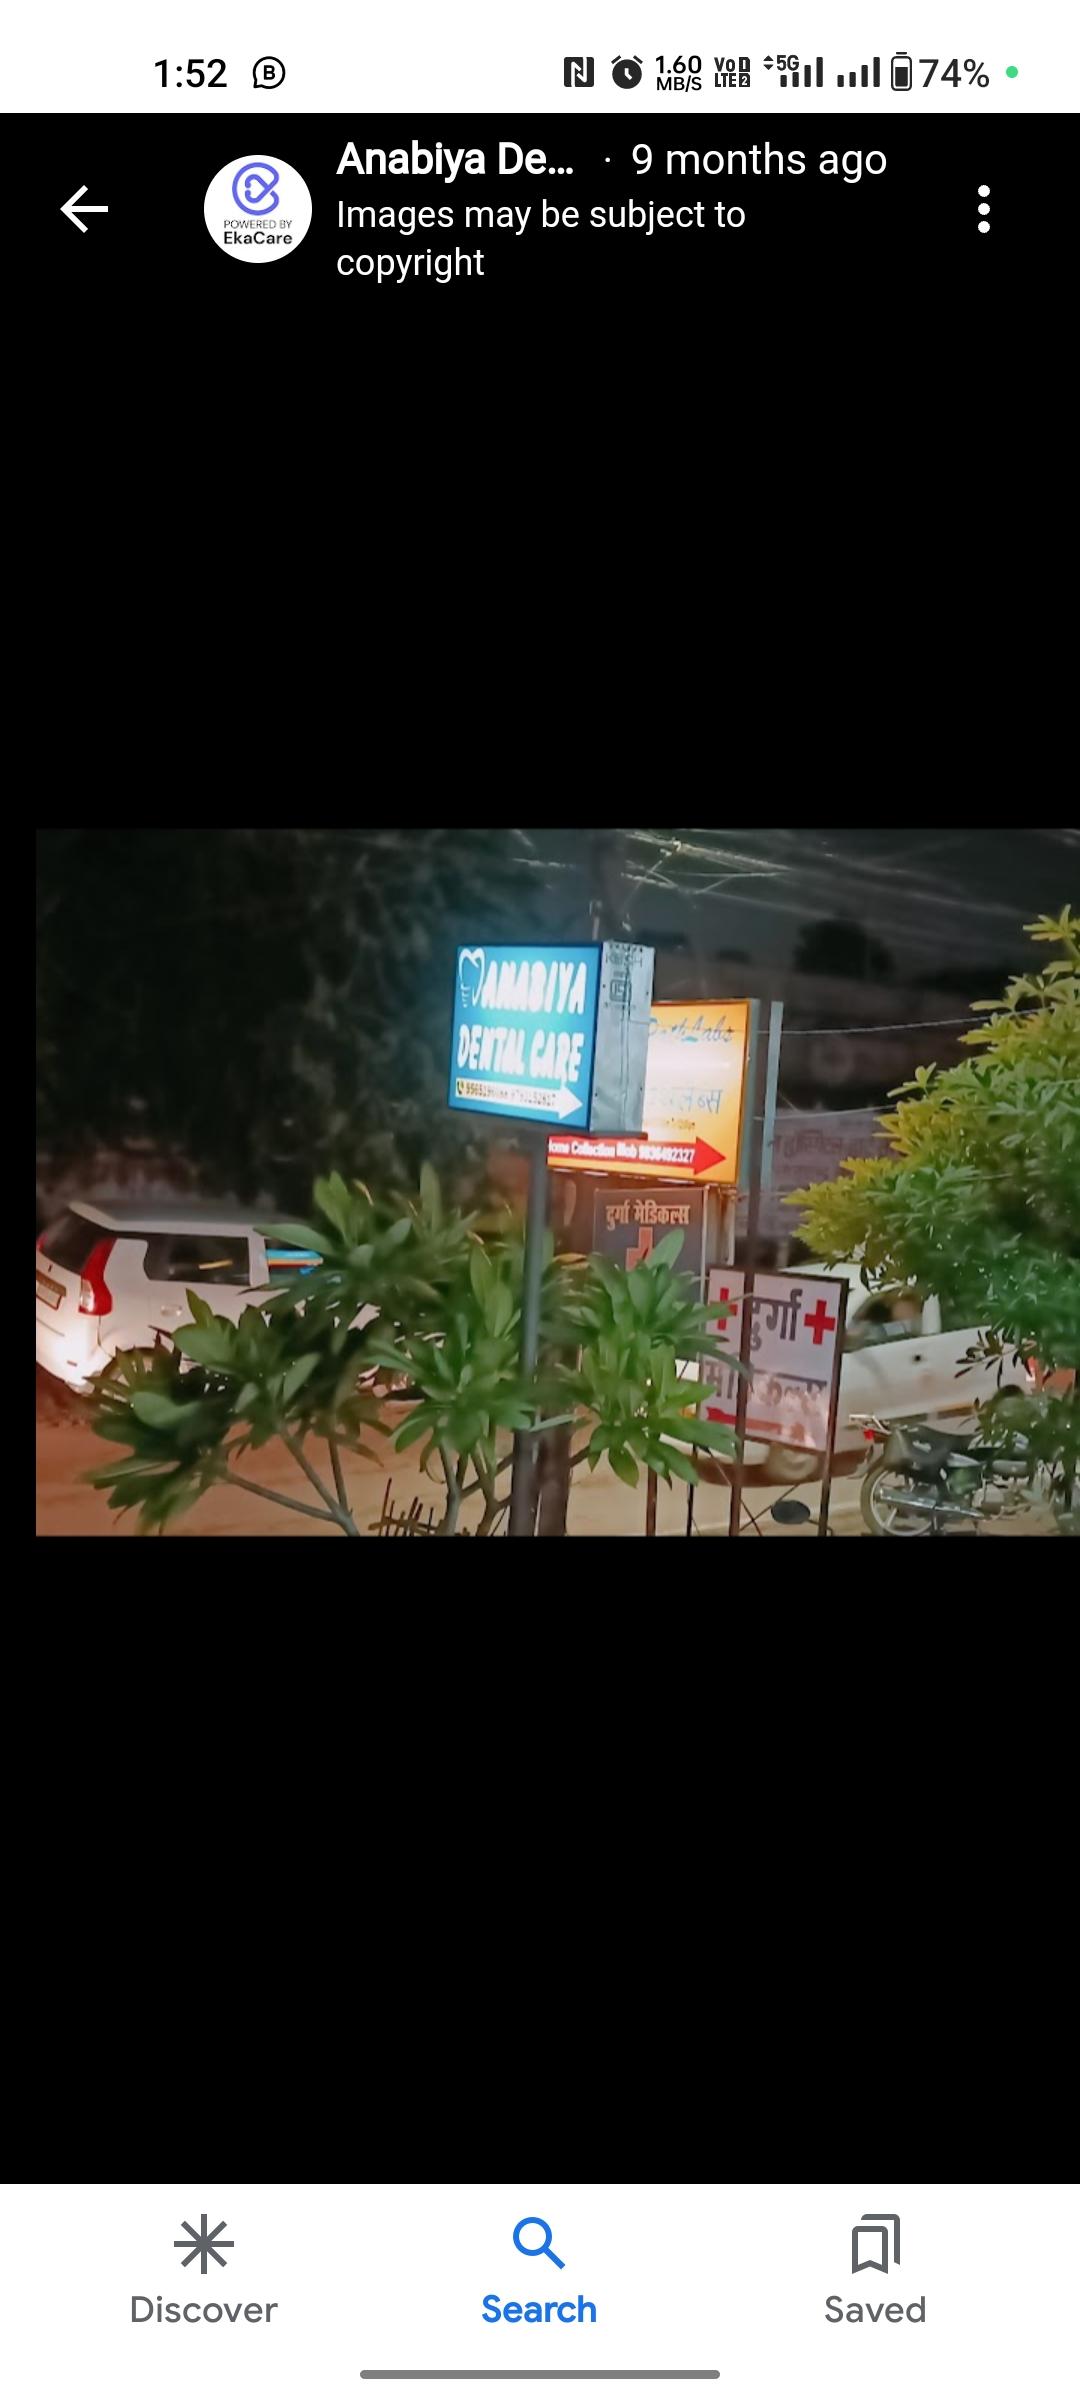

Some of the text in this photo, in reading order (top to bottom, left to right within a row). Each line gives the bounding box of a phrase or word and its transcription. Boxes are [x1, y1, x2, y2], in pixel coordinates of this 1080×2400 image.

[480, 960, 587, 1016] ANABIYA
[457, 1023, 585, 1085] DENTAL CARE
[606, 1199, 691, 1232] दुर्गा मेडिकल्स
